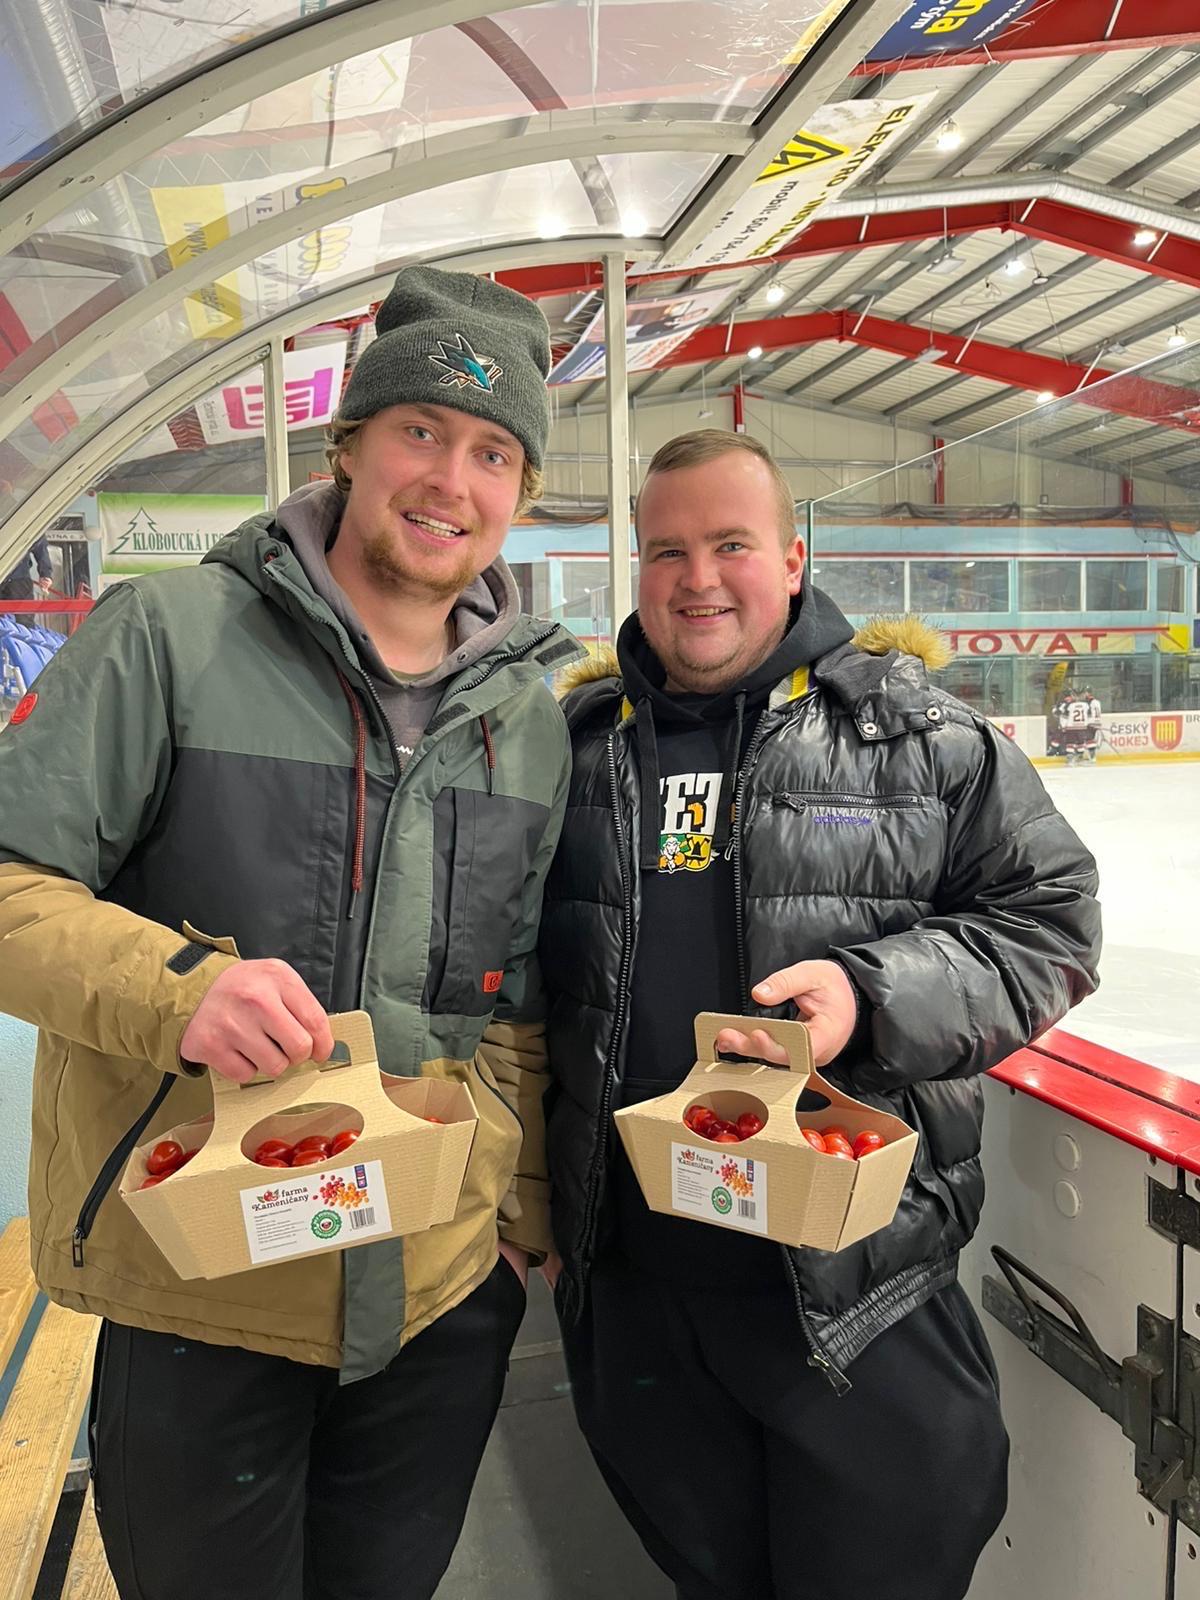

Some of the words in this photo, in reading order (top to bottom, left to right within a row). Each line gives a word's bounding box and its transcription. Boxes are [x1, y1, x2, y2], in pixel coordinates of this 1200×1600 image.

[826, 104, 914, 187] ELEKTRO
[759, 181, 799, 215] mobil:
[133, 529, 201, 551] KLOBOUCKÁ
[1073, 709, 1085, 722] 21
[1110, 721, 1149, 735] ČESKÝ
[1110, 735, 1149, 747] HOKEJ
[281, 1187, 308, 1198] farma
[252, 1195, 309, 1211] Kameničany
